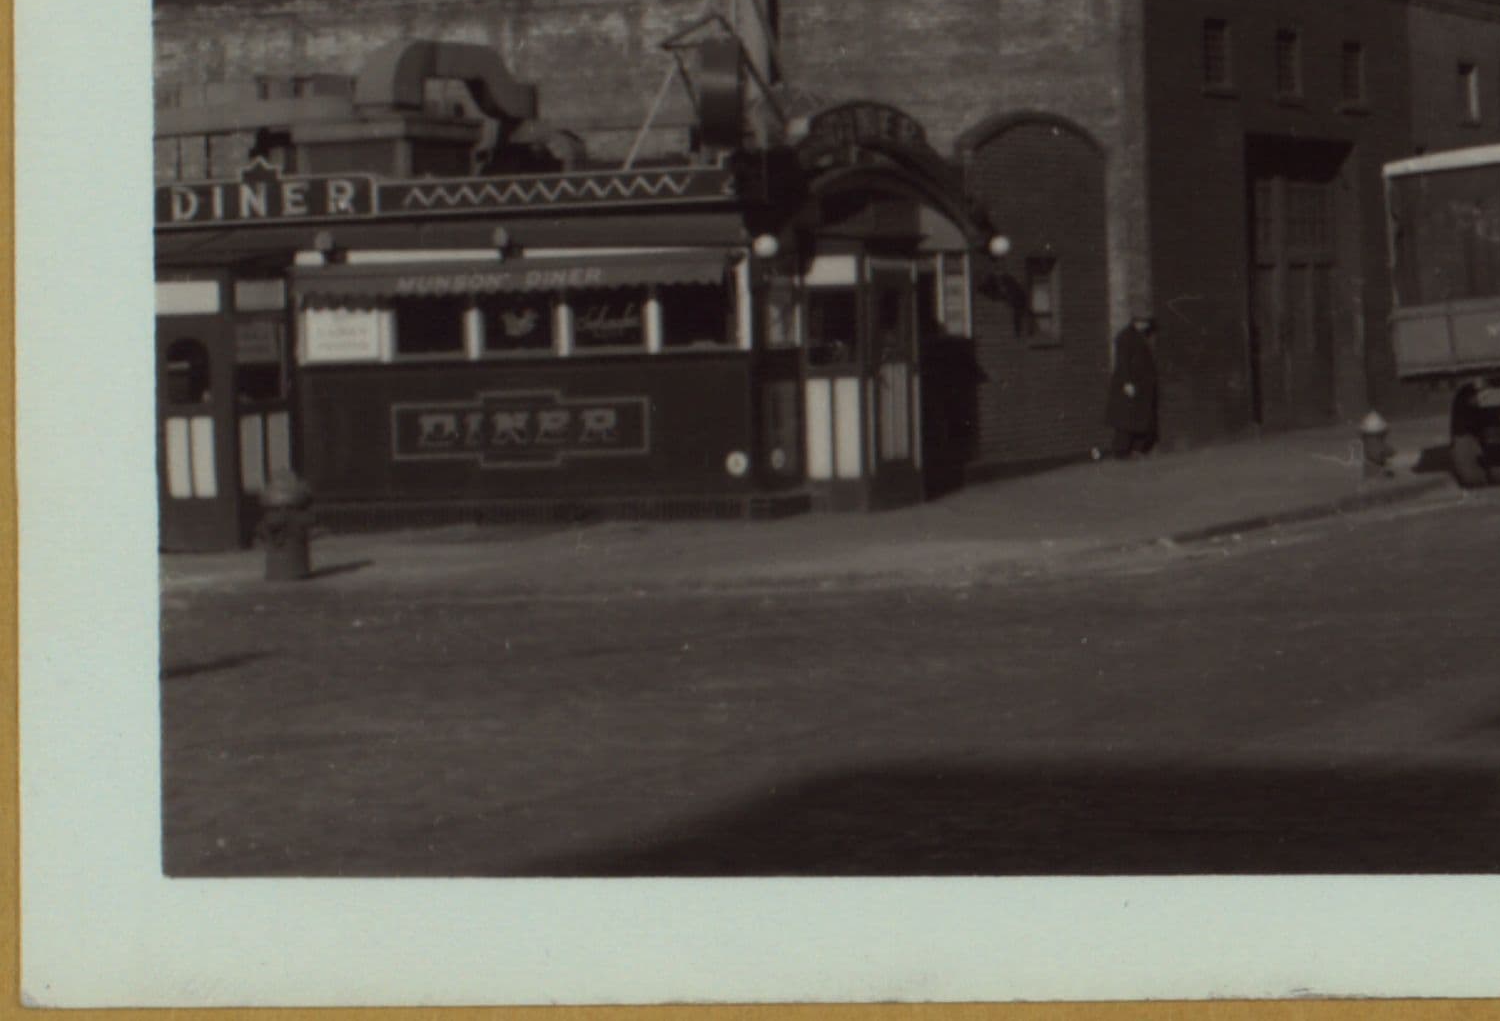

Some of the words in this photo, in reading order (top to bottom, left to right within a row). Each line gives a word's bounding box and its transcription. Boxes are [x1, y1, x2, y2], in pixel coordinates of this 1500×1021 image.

[171, 178, 355, 221] DINER
[525, 267, 602, 288] DINER
[416, 407, 617, 448] DINER
